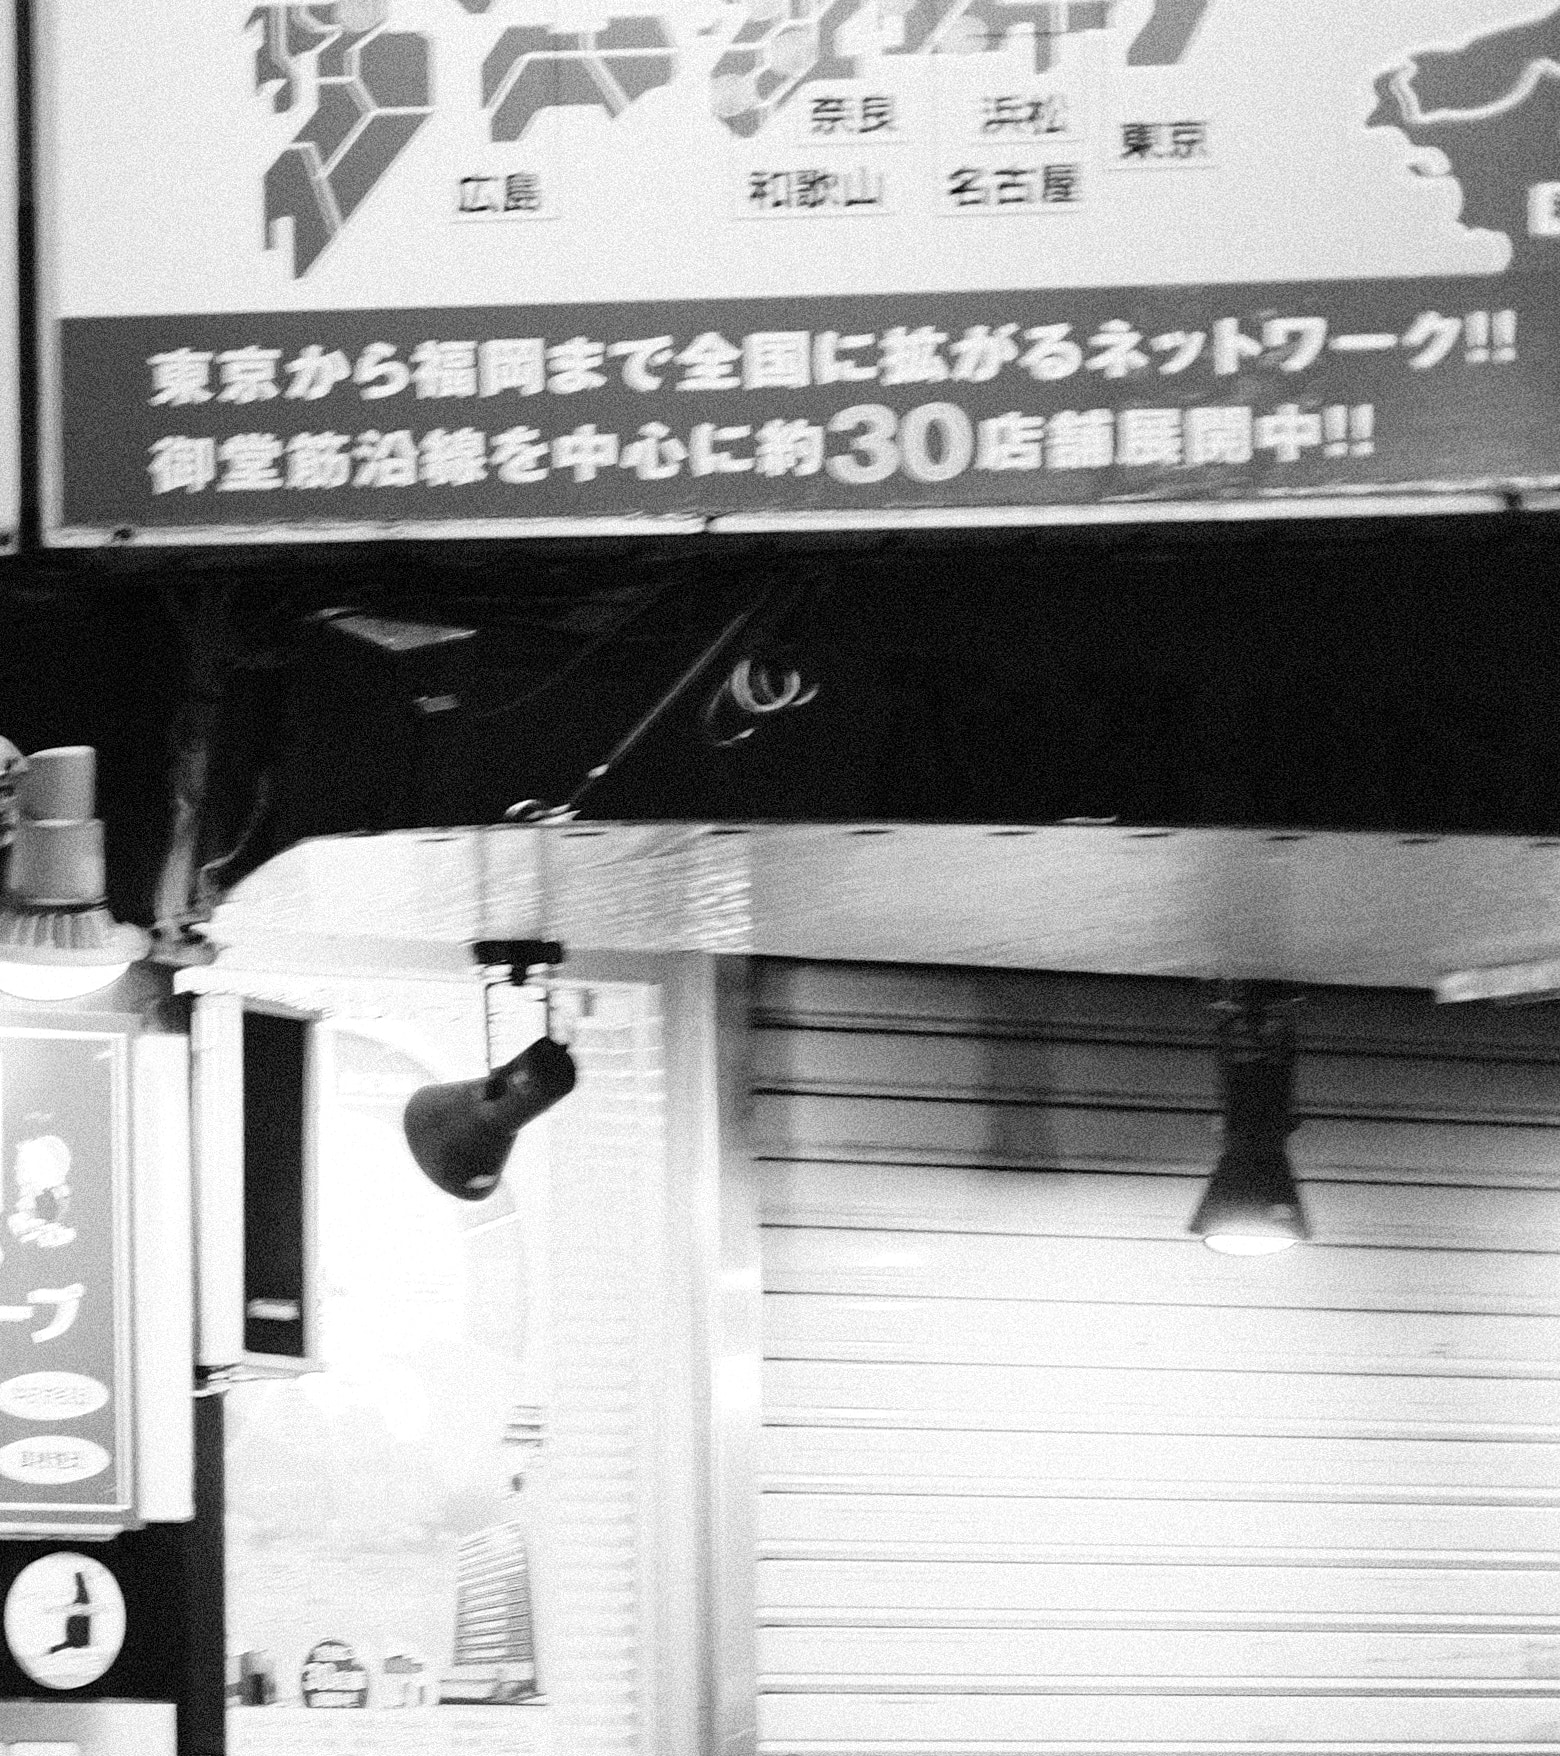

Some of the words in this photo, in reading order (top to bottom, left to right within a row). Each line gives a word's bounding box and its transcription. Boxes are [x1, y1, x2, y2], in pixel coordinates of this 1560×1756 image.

[810, 92, 898, 137] 奈良
[980, 94, 1067, 136] 浜松
[1121, 119, 1209, 161] 東京
[457, 173, 542, 215] 広島
[749, 166, 884, 210] 和歌山
[946, 162, 1080, 207] 名古屋
